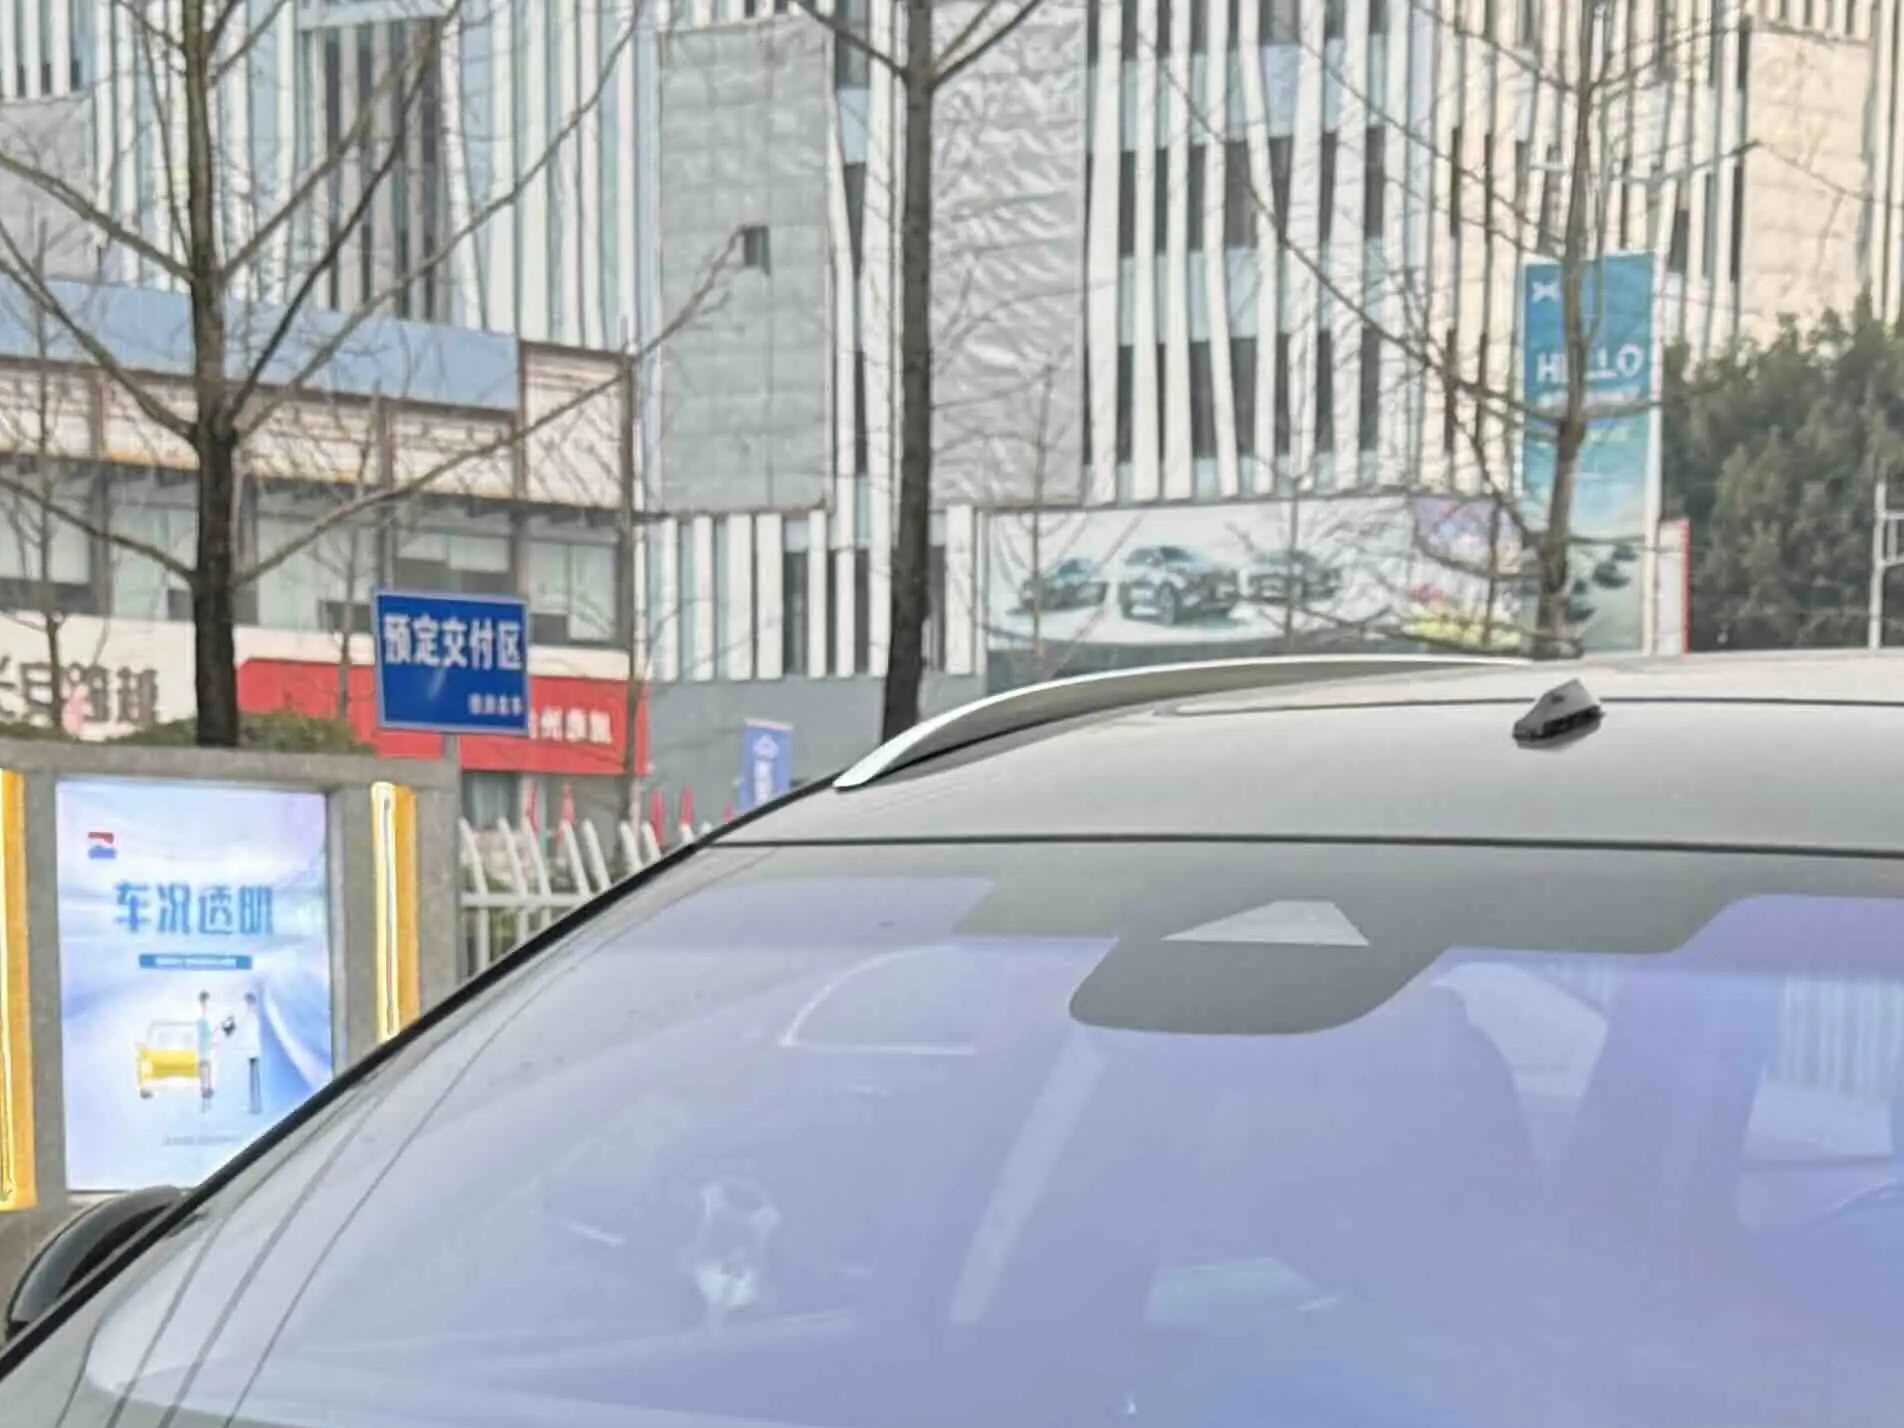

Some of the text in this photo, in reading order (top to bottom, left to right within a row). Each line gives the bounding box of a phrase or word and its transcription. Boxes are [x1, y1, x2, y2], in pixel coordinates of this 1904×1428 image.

[1536, 344, 1644, 384] HLO
[383, 612, 522, 671] 预定交付区
[113, 879, 275, 936] 车况透明
